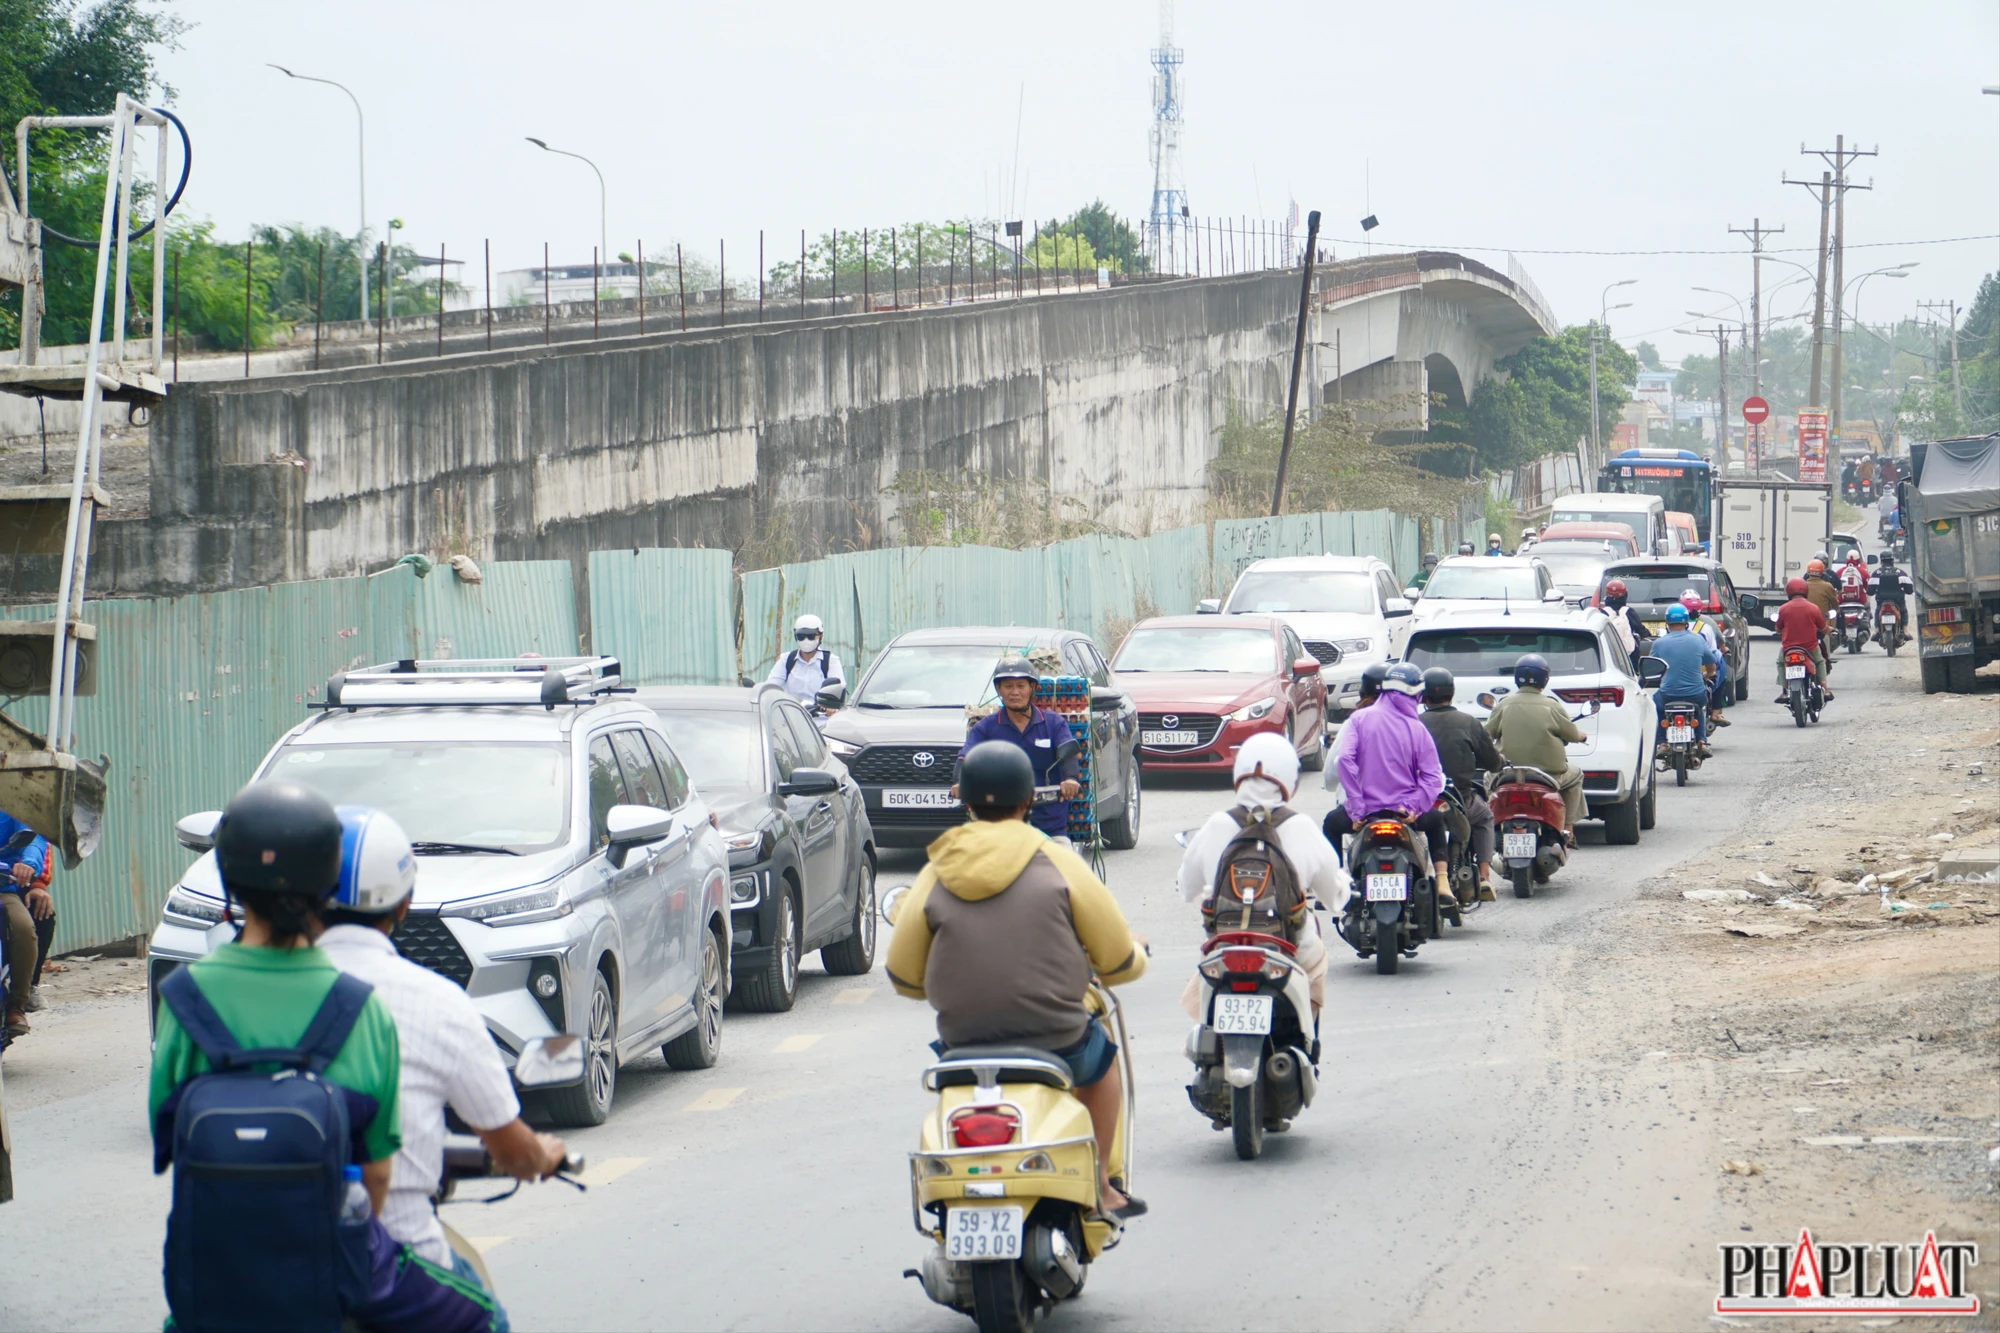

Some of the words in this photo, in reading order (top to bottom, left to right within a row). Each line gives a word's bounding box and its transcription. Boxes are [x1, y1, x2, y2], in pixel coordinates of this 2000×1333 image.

[1978, 516, 1999, 532] 51C
[1508, 835, 1531, 846] 59-X2
[1505, 847, 1534, 856] 410.60
[1373, 876, 1400, 888] 61-CA
[1370, 888, 1404, 899] 080.01
[1225, 998, 1262, 1014] 93-P2
[1218, 1015, 1266, 1031] 675.94
[959, 1212, 1011, 1232] 59-X2
[951, 1235, 1017, 1256] 393.09
